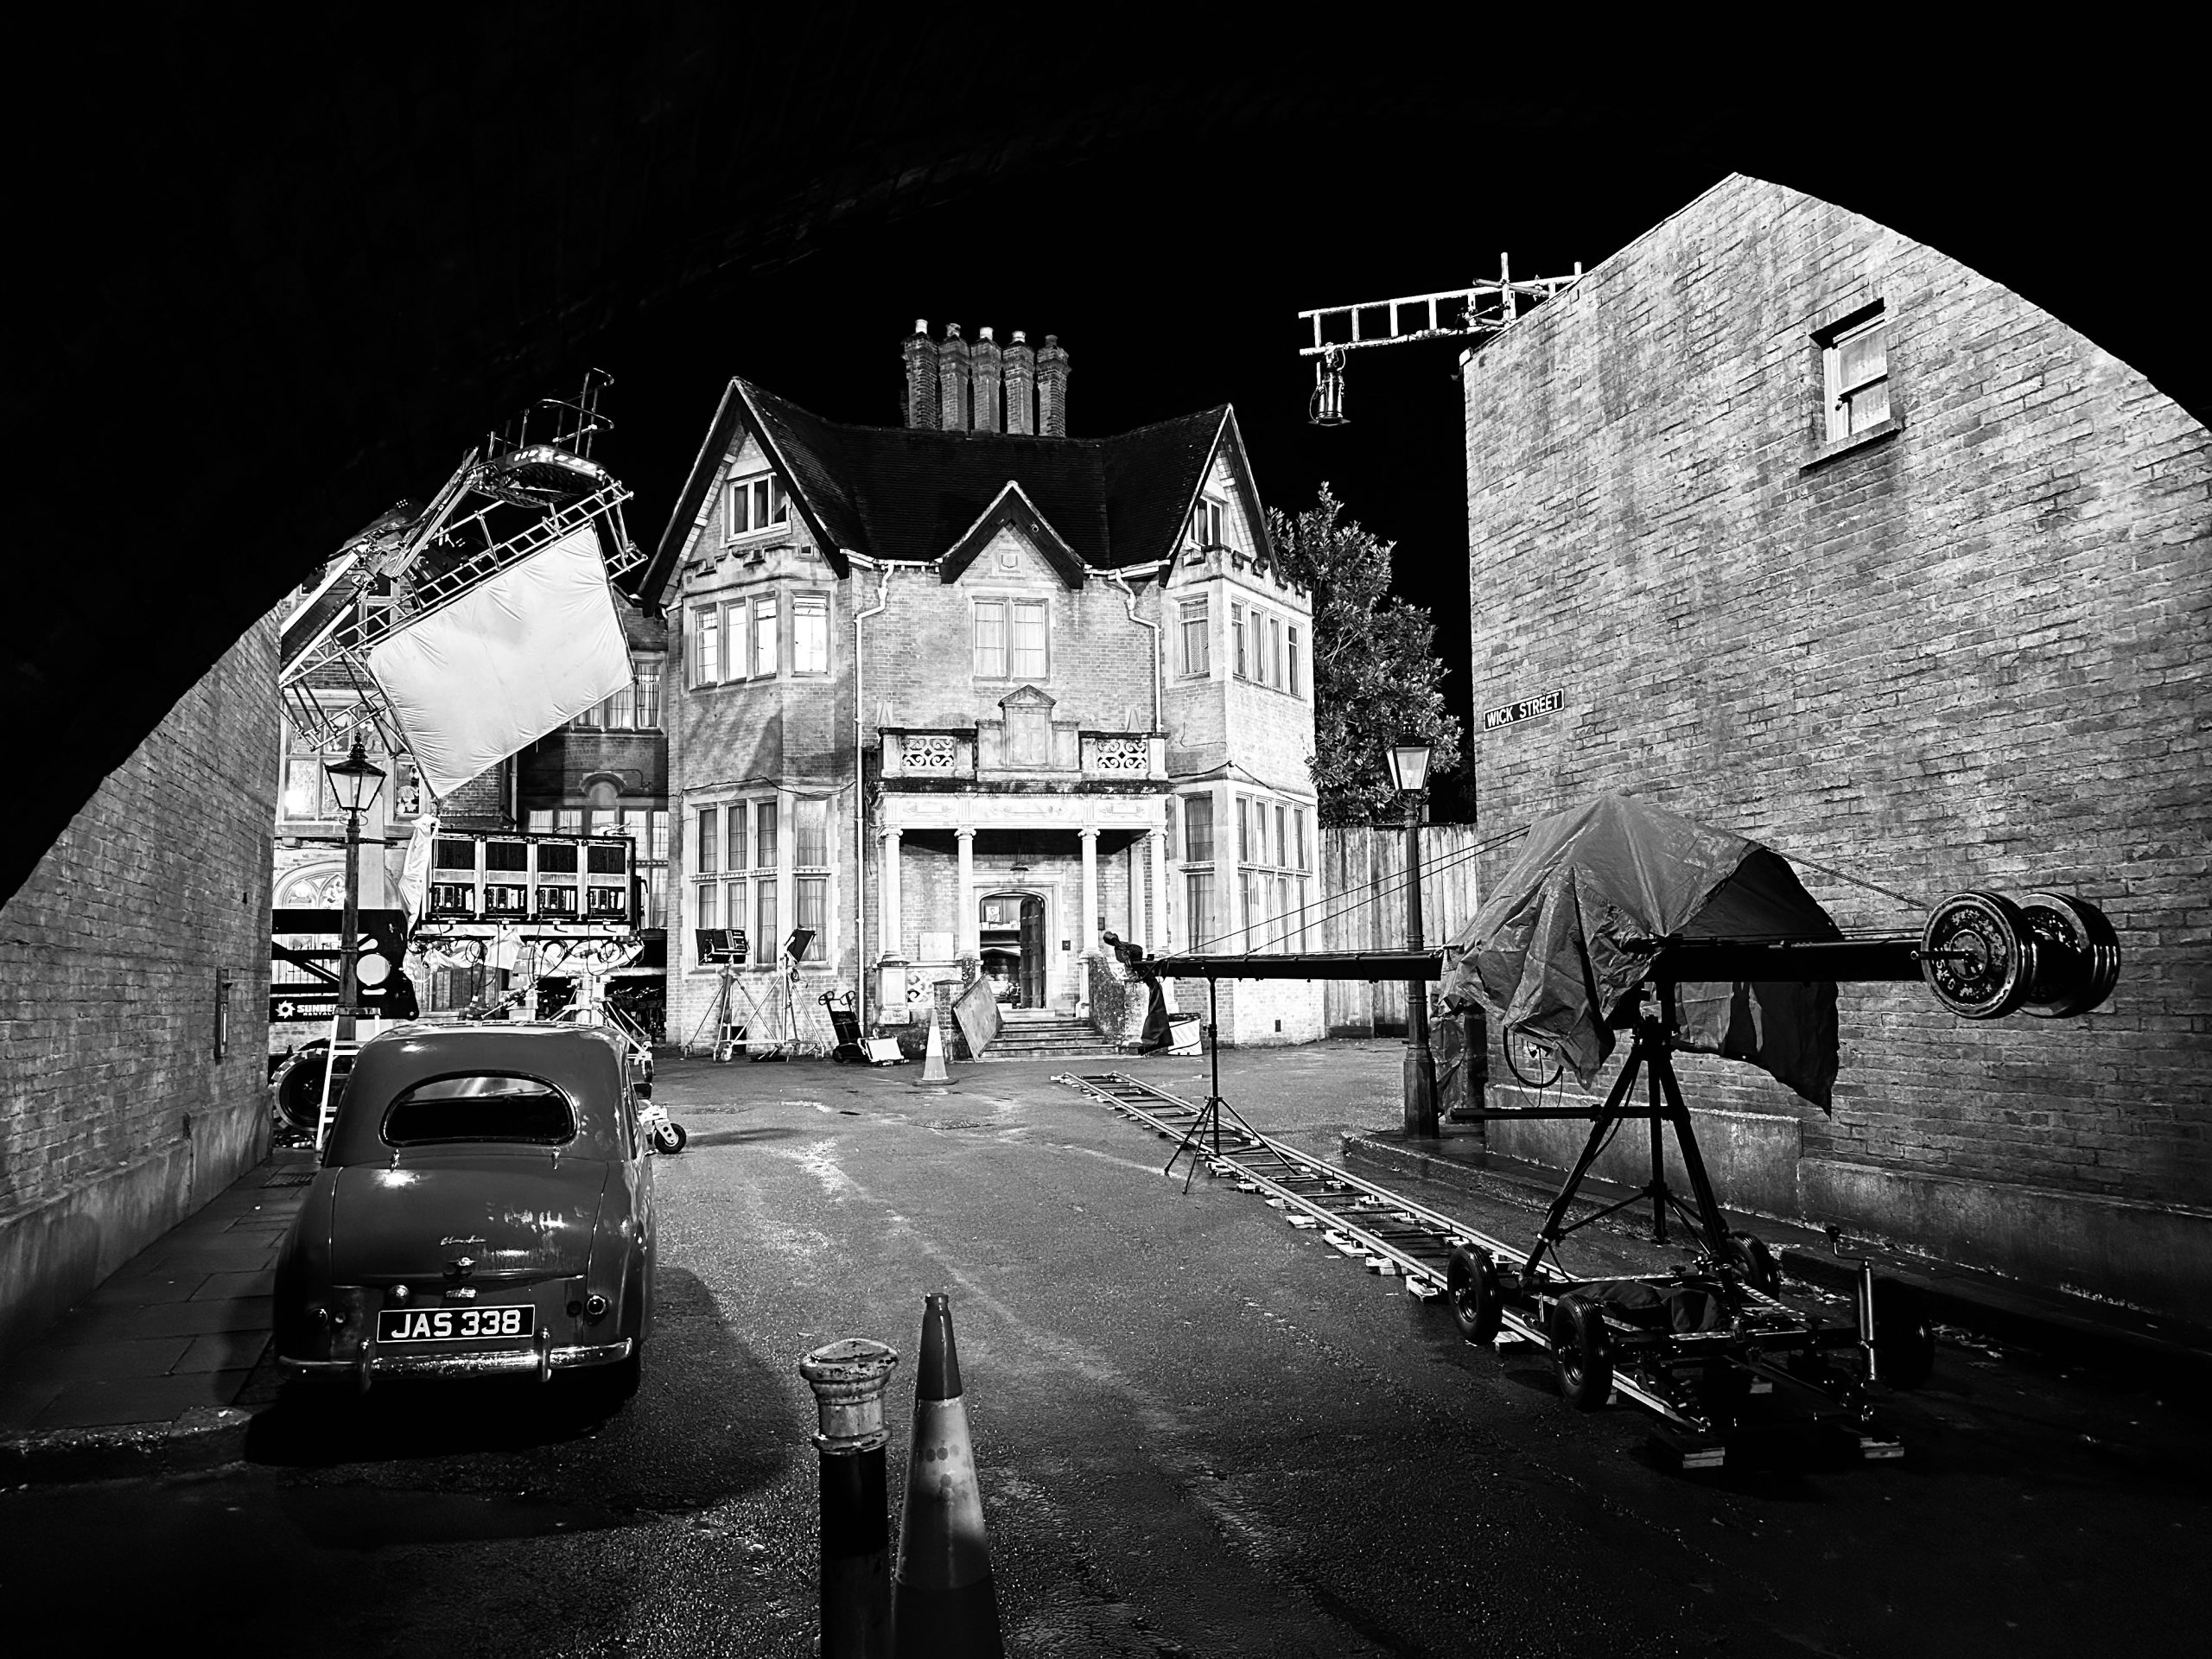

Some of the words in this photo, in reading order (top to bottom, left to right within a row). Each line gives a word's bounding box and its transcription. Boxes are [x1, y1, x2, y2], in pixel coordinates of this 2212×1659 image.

[1486, 706, 1514, 728] WICK
[1519, 692, 1560, 719] STREET
[391, 1312, 452, 1338] JAS
[461, 1309, 521, 1336] 338
